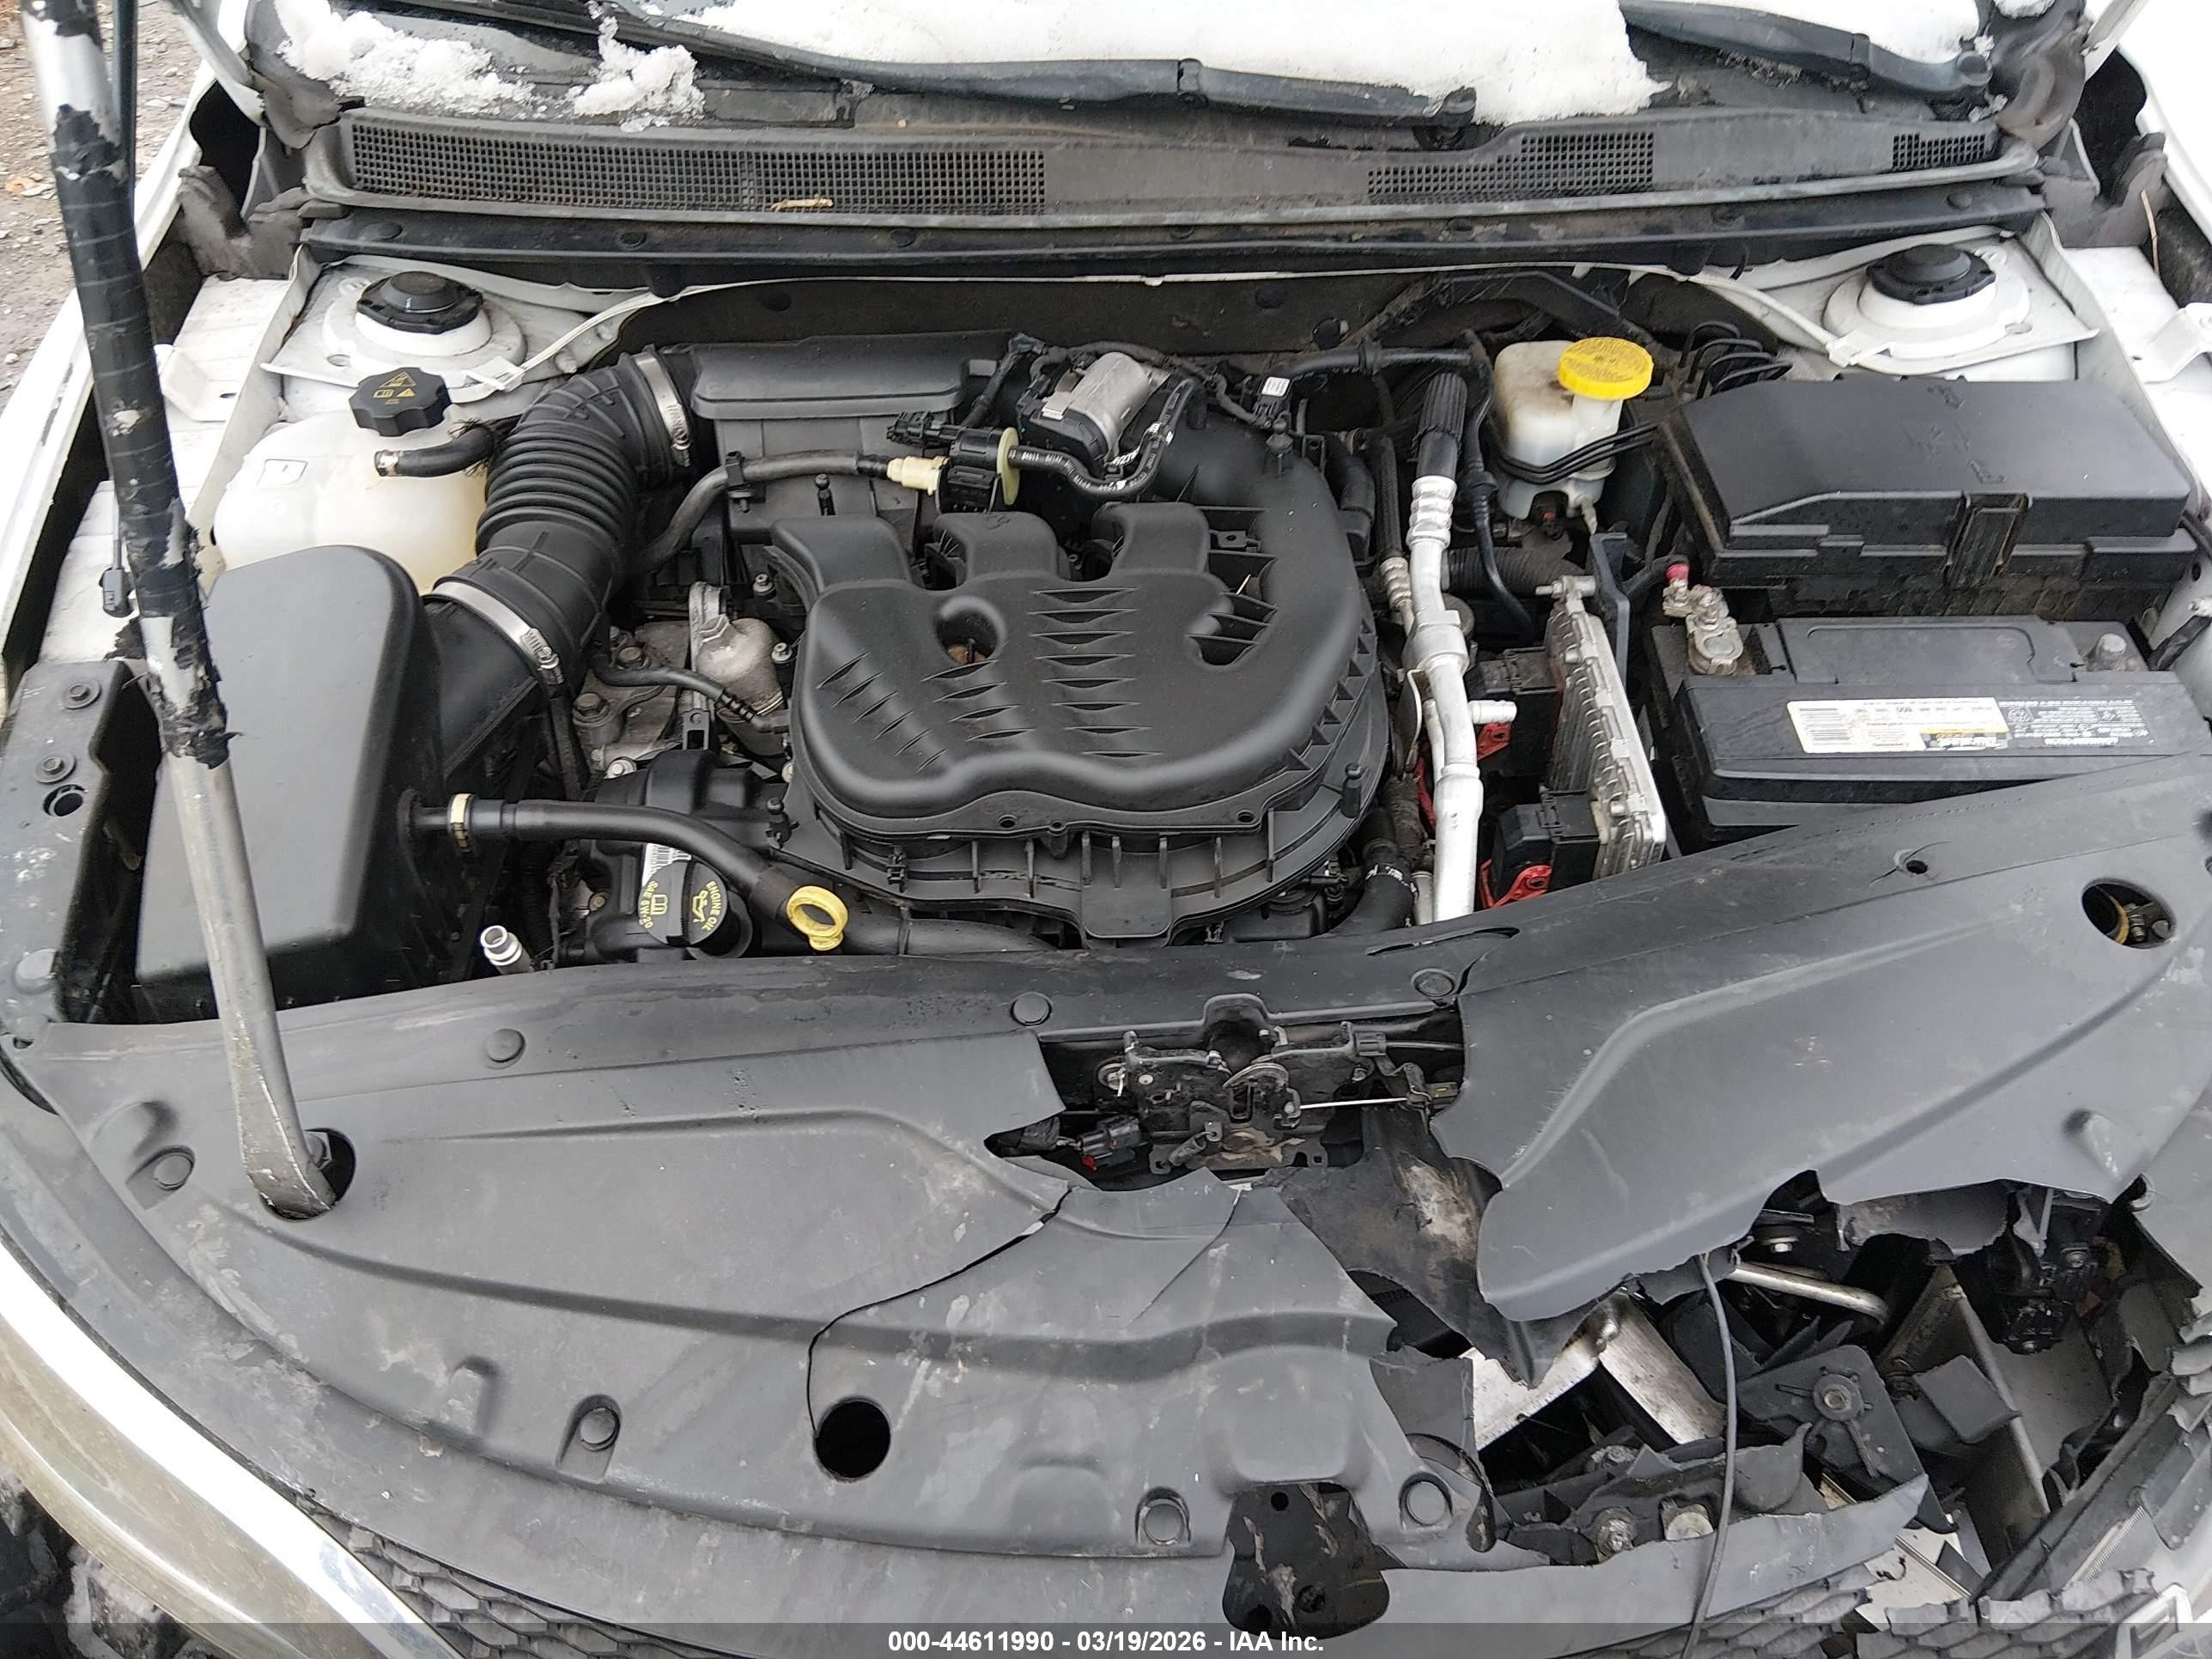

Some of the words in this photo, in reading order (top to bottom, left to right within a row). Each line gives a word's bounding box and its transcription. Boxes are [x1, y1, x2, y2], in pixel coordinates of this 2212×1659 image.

[642, 880, 659, 899] SAE
[706, 880, 722, 916] ENGINE
[702, 916, 718, 932] OIL
